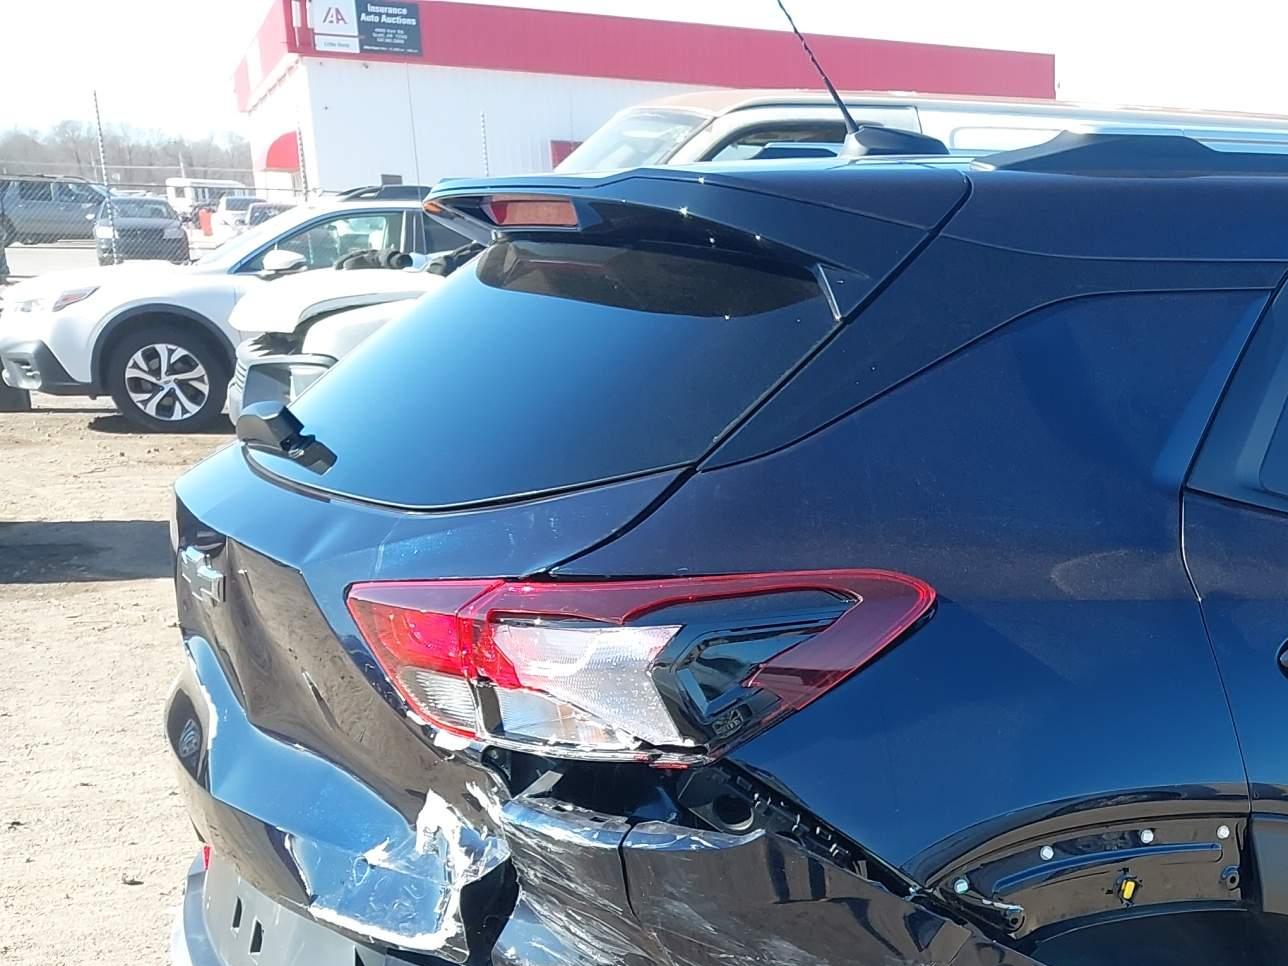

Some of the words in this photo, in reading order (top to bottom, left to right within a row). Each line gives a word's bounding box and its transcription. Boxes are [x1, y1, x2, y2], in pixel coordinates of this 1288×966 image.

[367, 3, 408, 15] Insurance
[360, 13, 379, 23] Auto
[381, 14, 417, 25] Auctions
